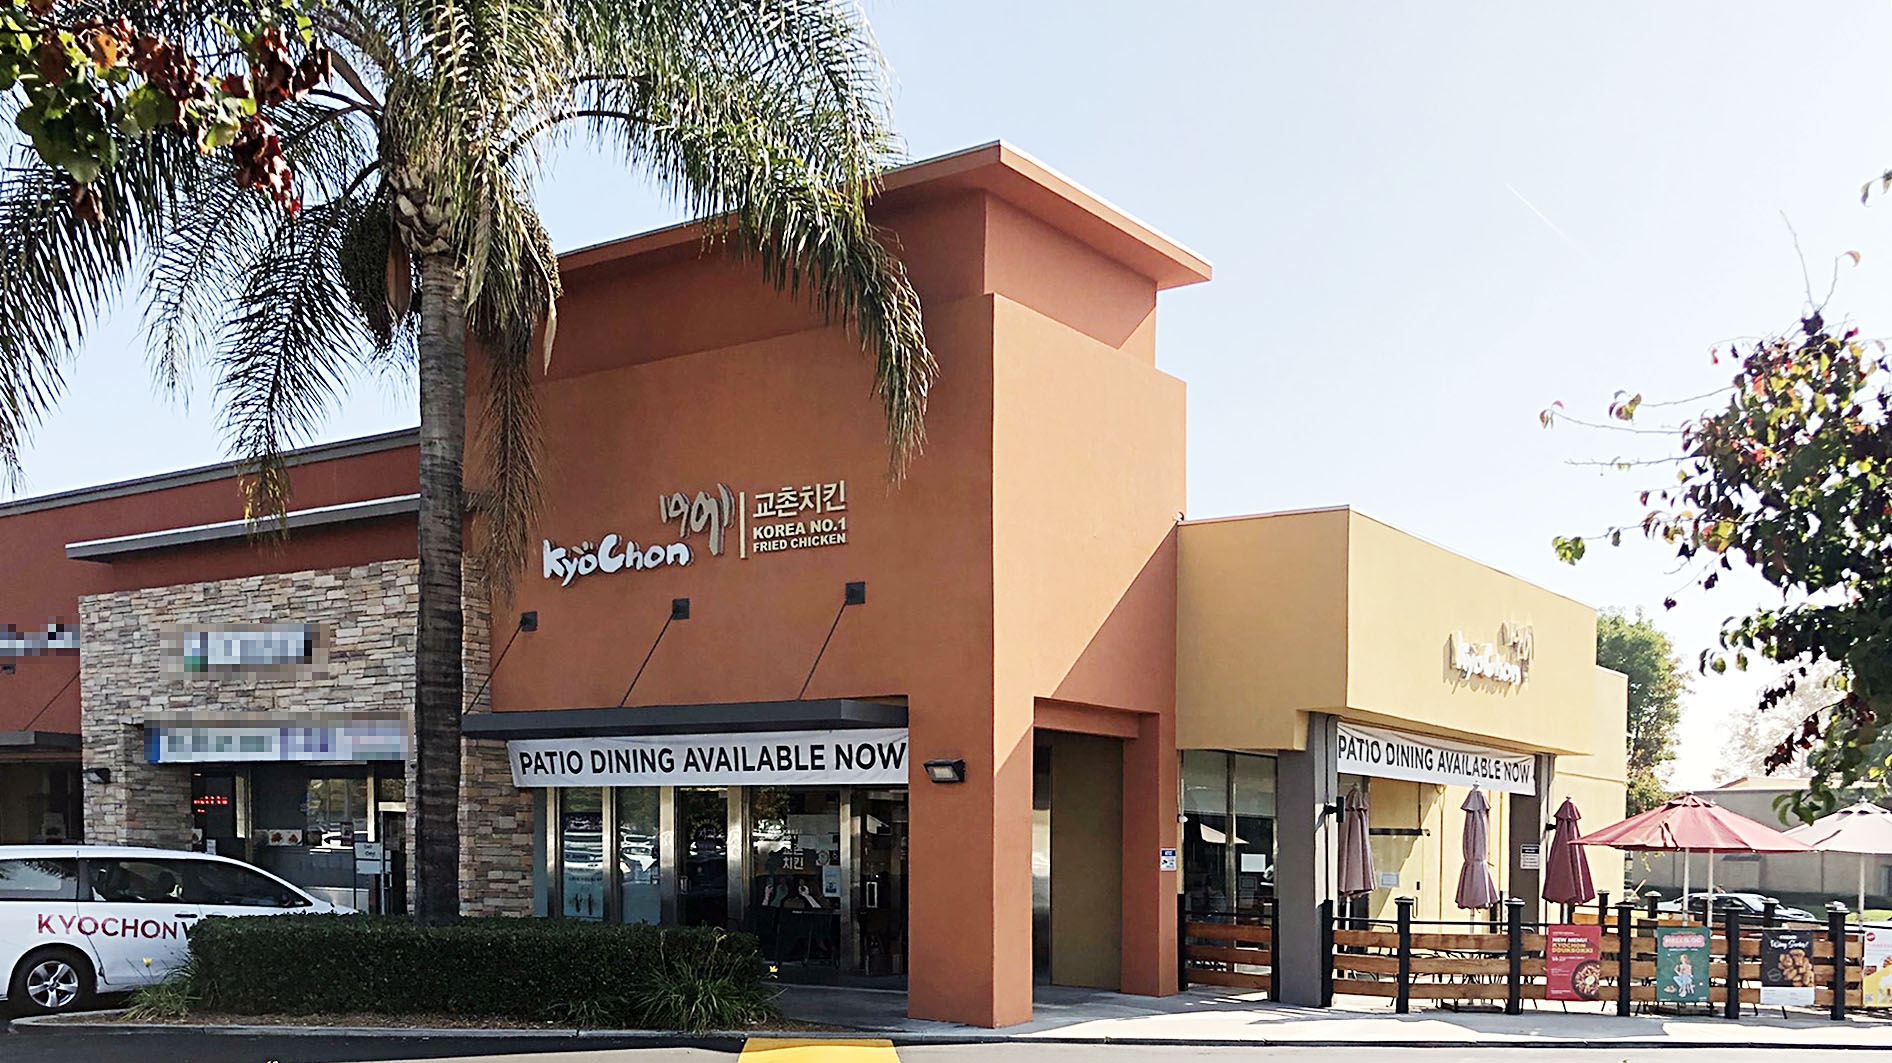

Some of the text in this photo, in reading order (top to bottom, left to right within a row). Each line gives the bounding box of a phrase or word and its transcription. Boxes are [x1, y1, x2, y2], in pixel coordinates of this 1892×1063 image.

[752, 481, 846, 518] 교촌치킨
[753, 517, 846, 540] KOREA NO.1
[753, 533, 846, 553] FRIED CHICKEN
[519, 742, 908, 775] PATIO DINING AVAILABLE NOW
[1338, 735, 1531, 784] PATIO DINING AVAILABLE NOW
[36, 913, 178, 940] KYOCHON
